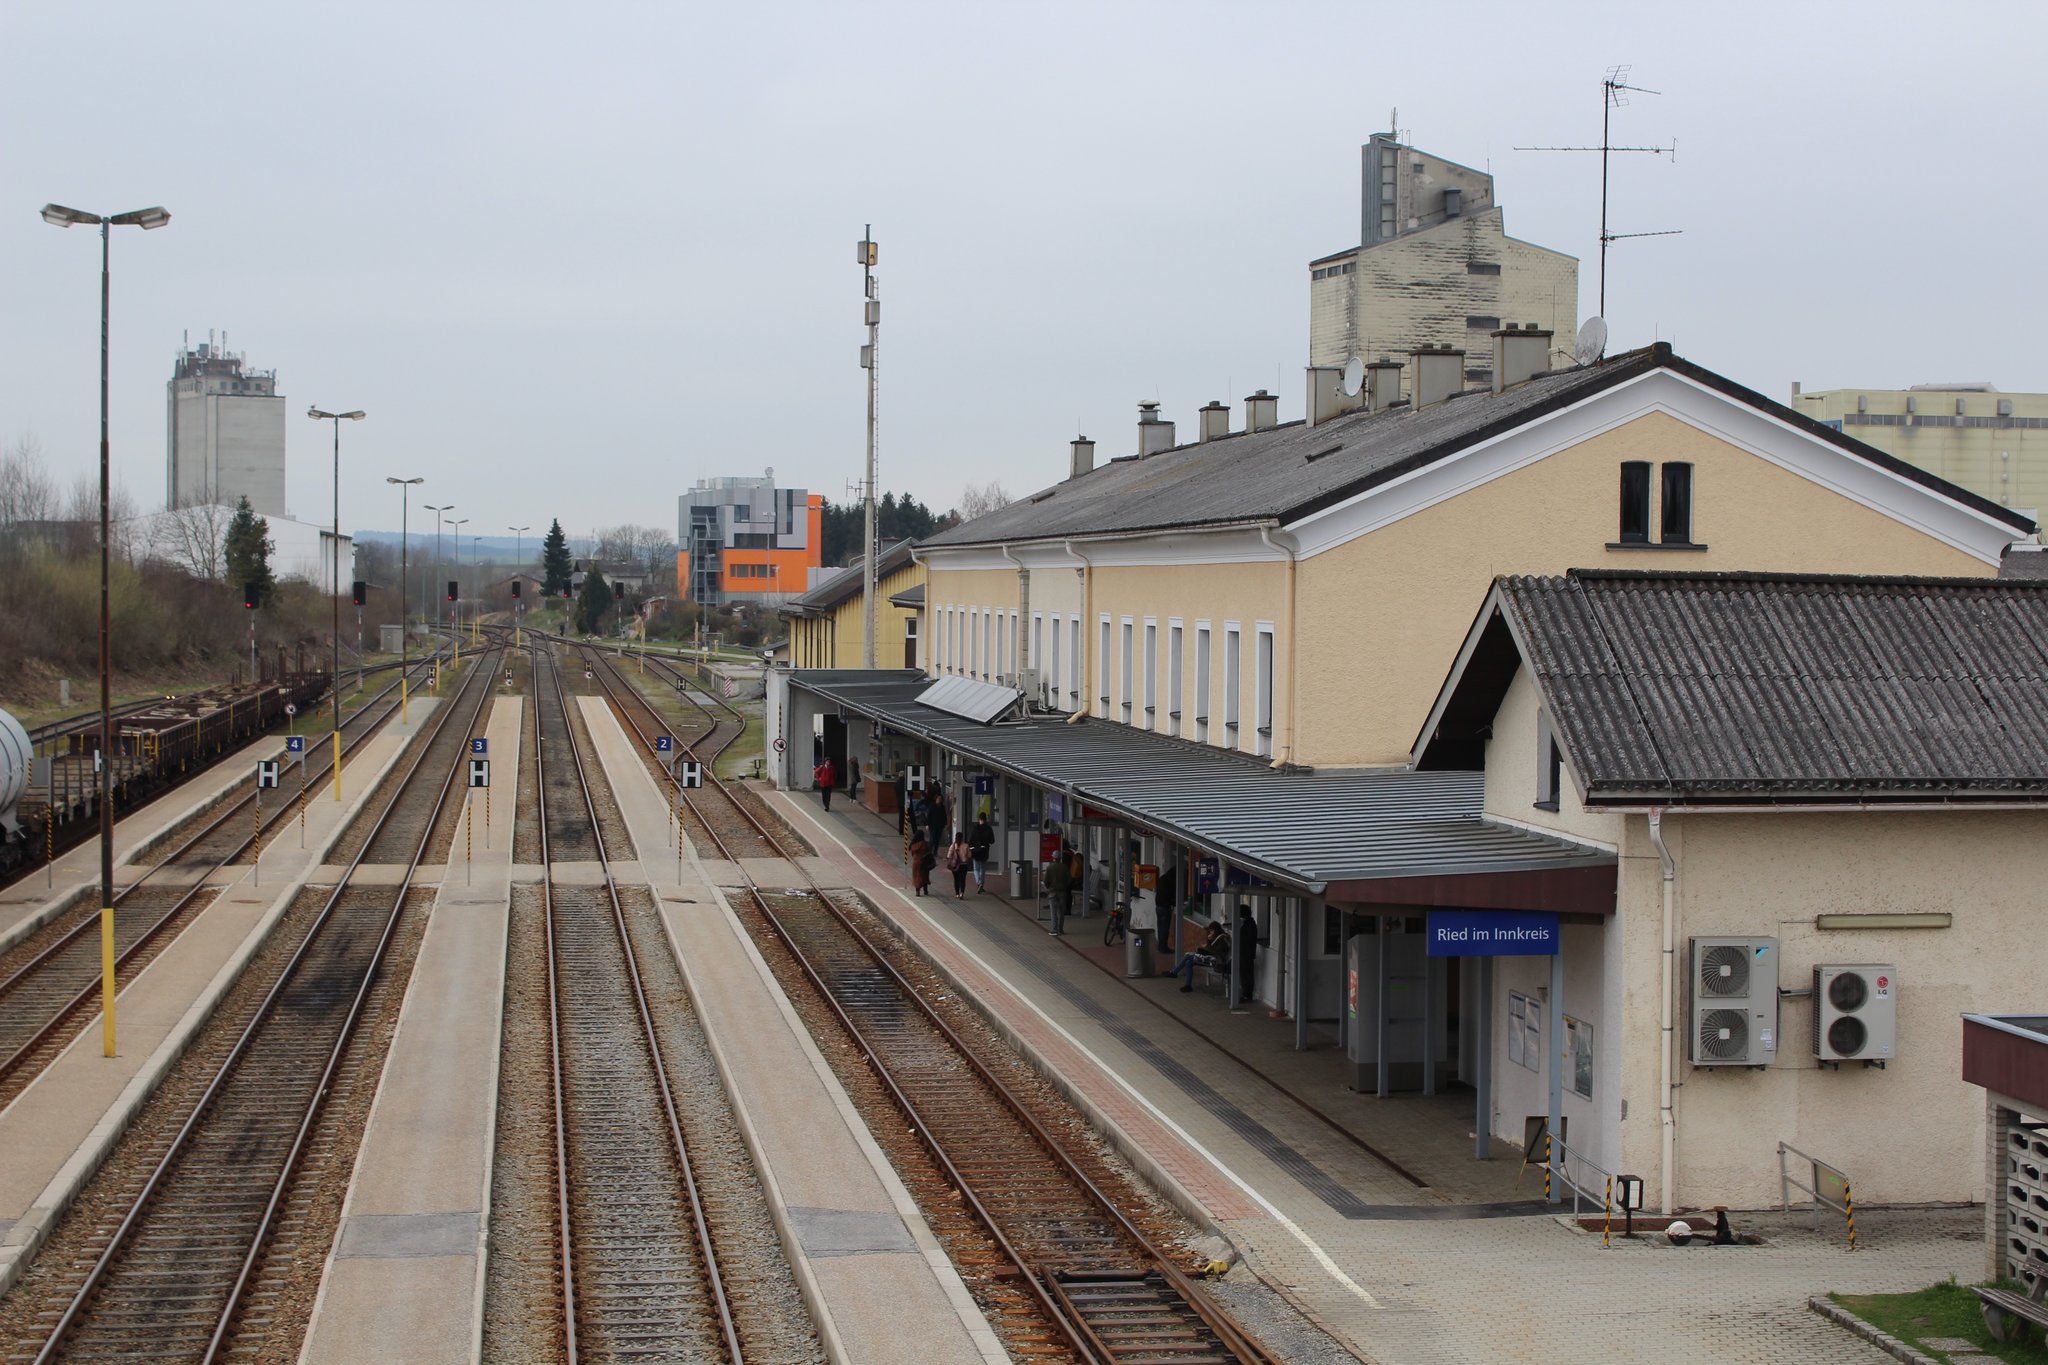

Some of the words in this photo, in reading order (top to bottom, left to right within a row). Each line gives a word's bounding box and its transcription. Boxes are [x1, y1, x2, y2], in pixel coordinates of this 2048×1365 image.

[585, 662, 592, 670] H
[428, 668, 435, 676] H
[505, 669, 512, 678] H
[678, 680, 686, 689] H
[291, 740, 298, 748] 4
[475, 741, 482, 750] 3
[660, 740, 667, 748] 2
[258, 762, 278, 788] H
[470, 761, 488, 786] H
[682, 762, 701, 787] H
[907, 766, 925, 791] H
[982, 780, 987, 792] 1
[1437, 928, 1468, 941] Ried
[1472, 928, 1489, 940] im
[1494, 926, 1550, 940] Innkreis
